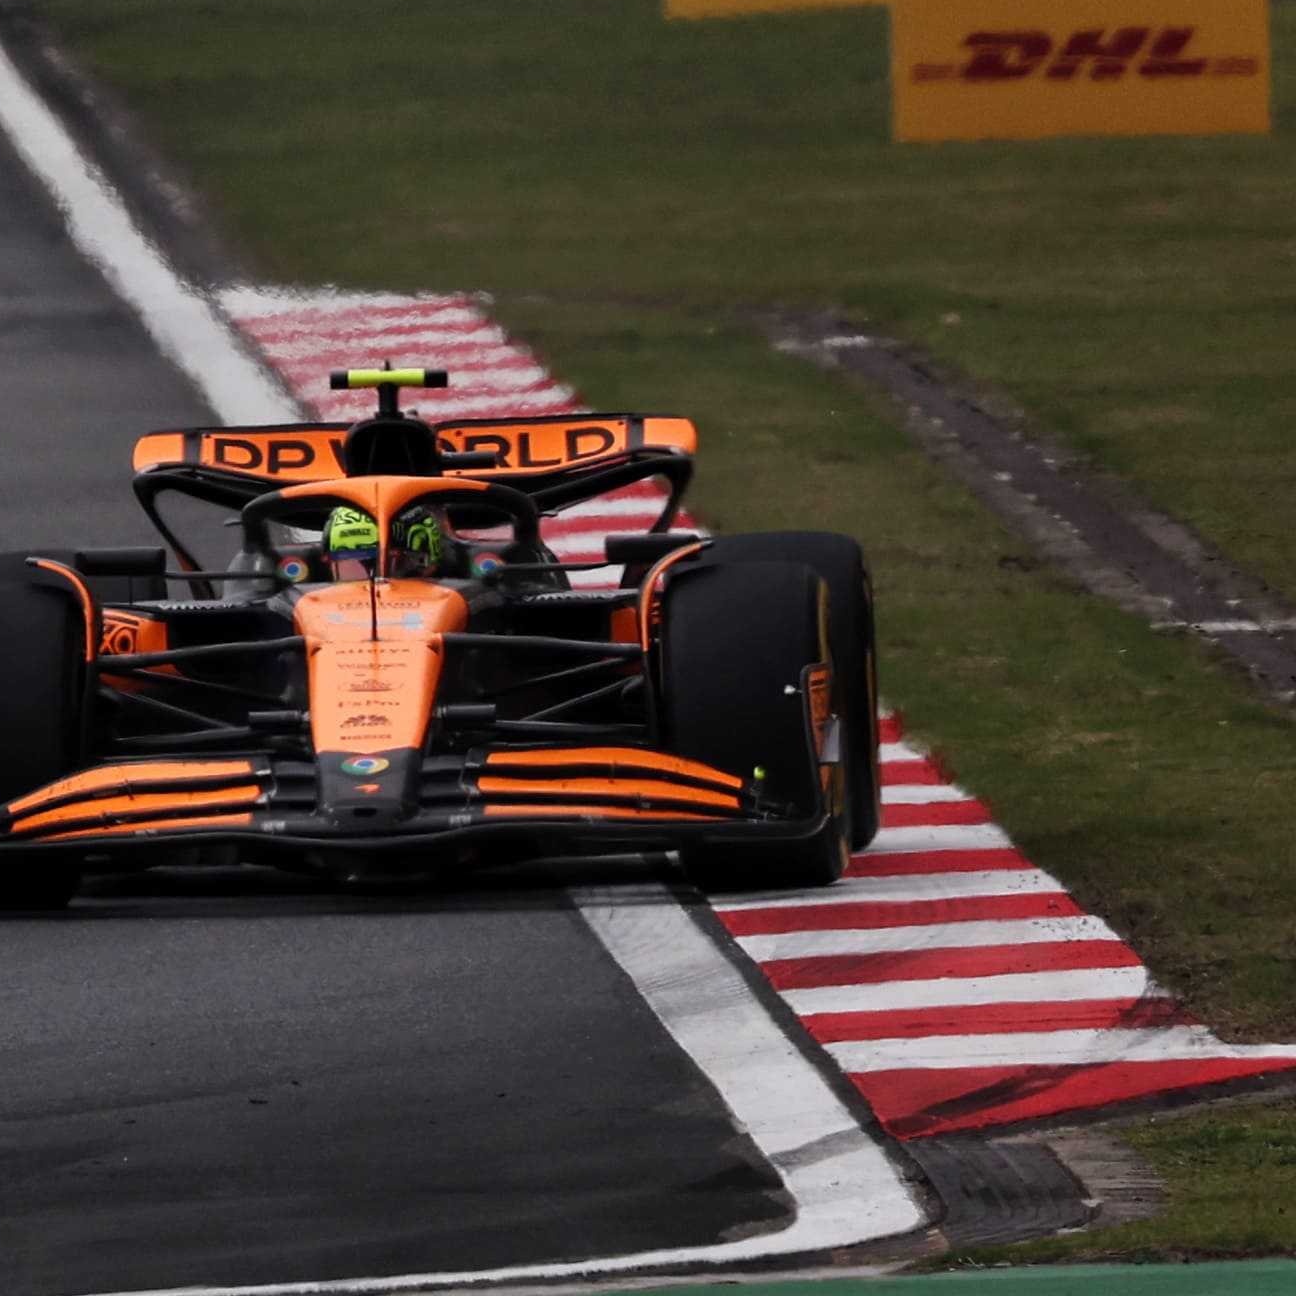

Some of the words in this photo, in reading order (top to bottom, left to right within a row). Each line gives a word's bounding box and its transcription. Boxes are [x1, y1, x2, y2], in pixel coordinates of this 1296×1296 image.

[962, 27, 1208, 81] DHL
[213, 437, 316, 474] DP
[328, 426, 615, 478] RLD
